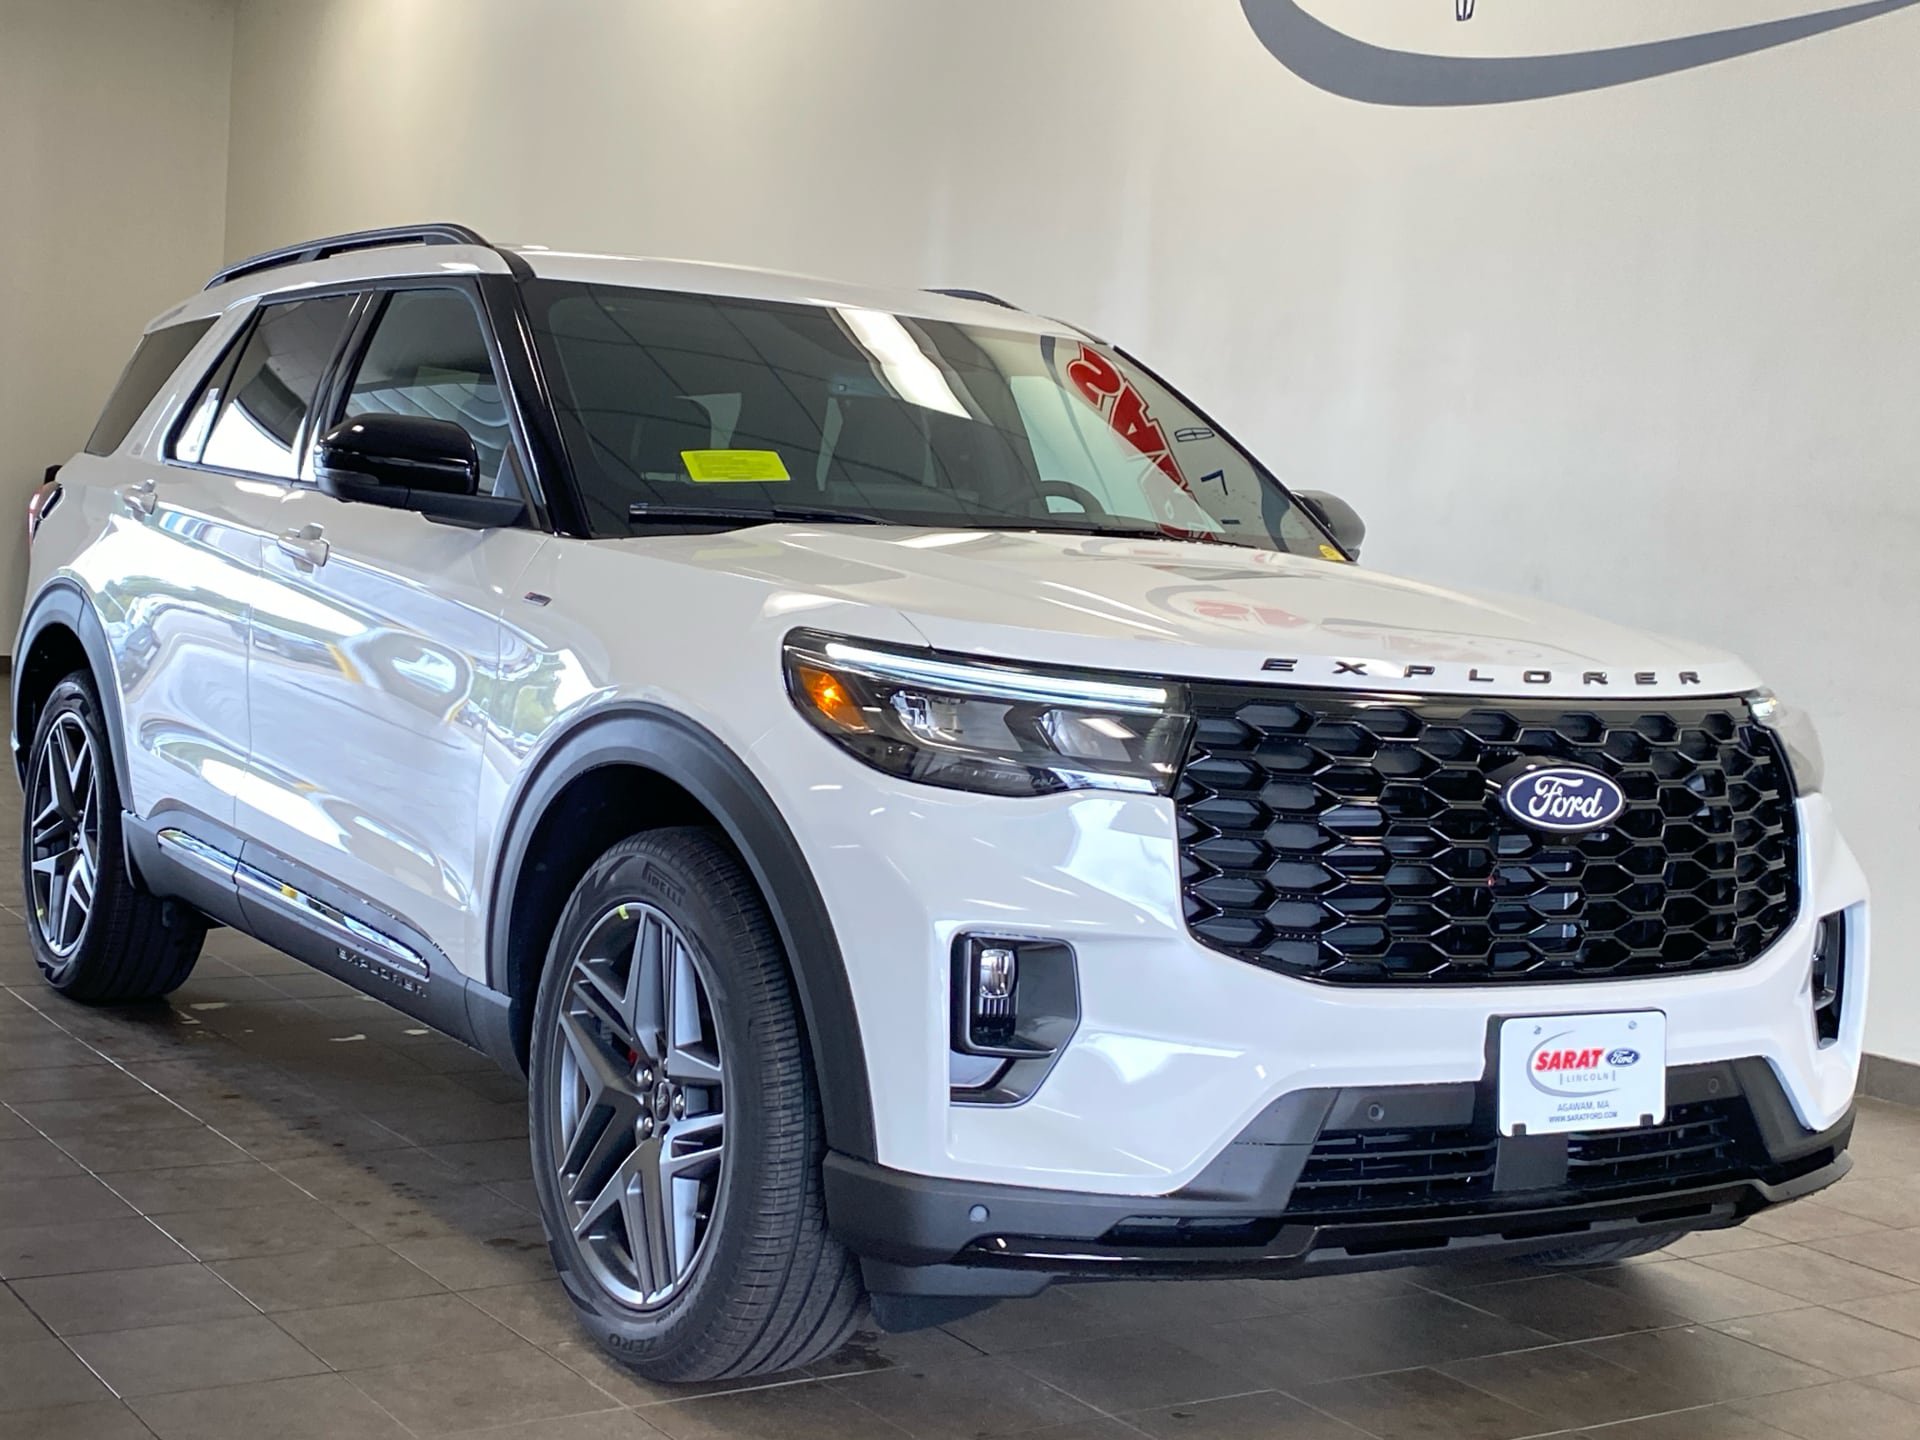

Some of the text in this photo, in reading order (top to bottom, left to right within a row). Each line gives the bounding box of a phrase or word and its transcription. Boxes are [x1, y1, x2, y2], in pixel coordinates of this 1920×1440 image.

[1261, 658, 1701, 684] EXPLORER
[1528, 776, 1603, 818] Ford
[642, 861, 686, 907] PIRELLI
[1535, 1048, 1604, 1071] SARAT
[1566, 1072, 1609, 1083] LINCOLN
[1557, 1100, 1610, 1112] AGAWAM, MA
[608, 1333, 657, 1352] ZERO
